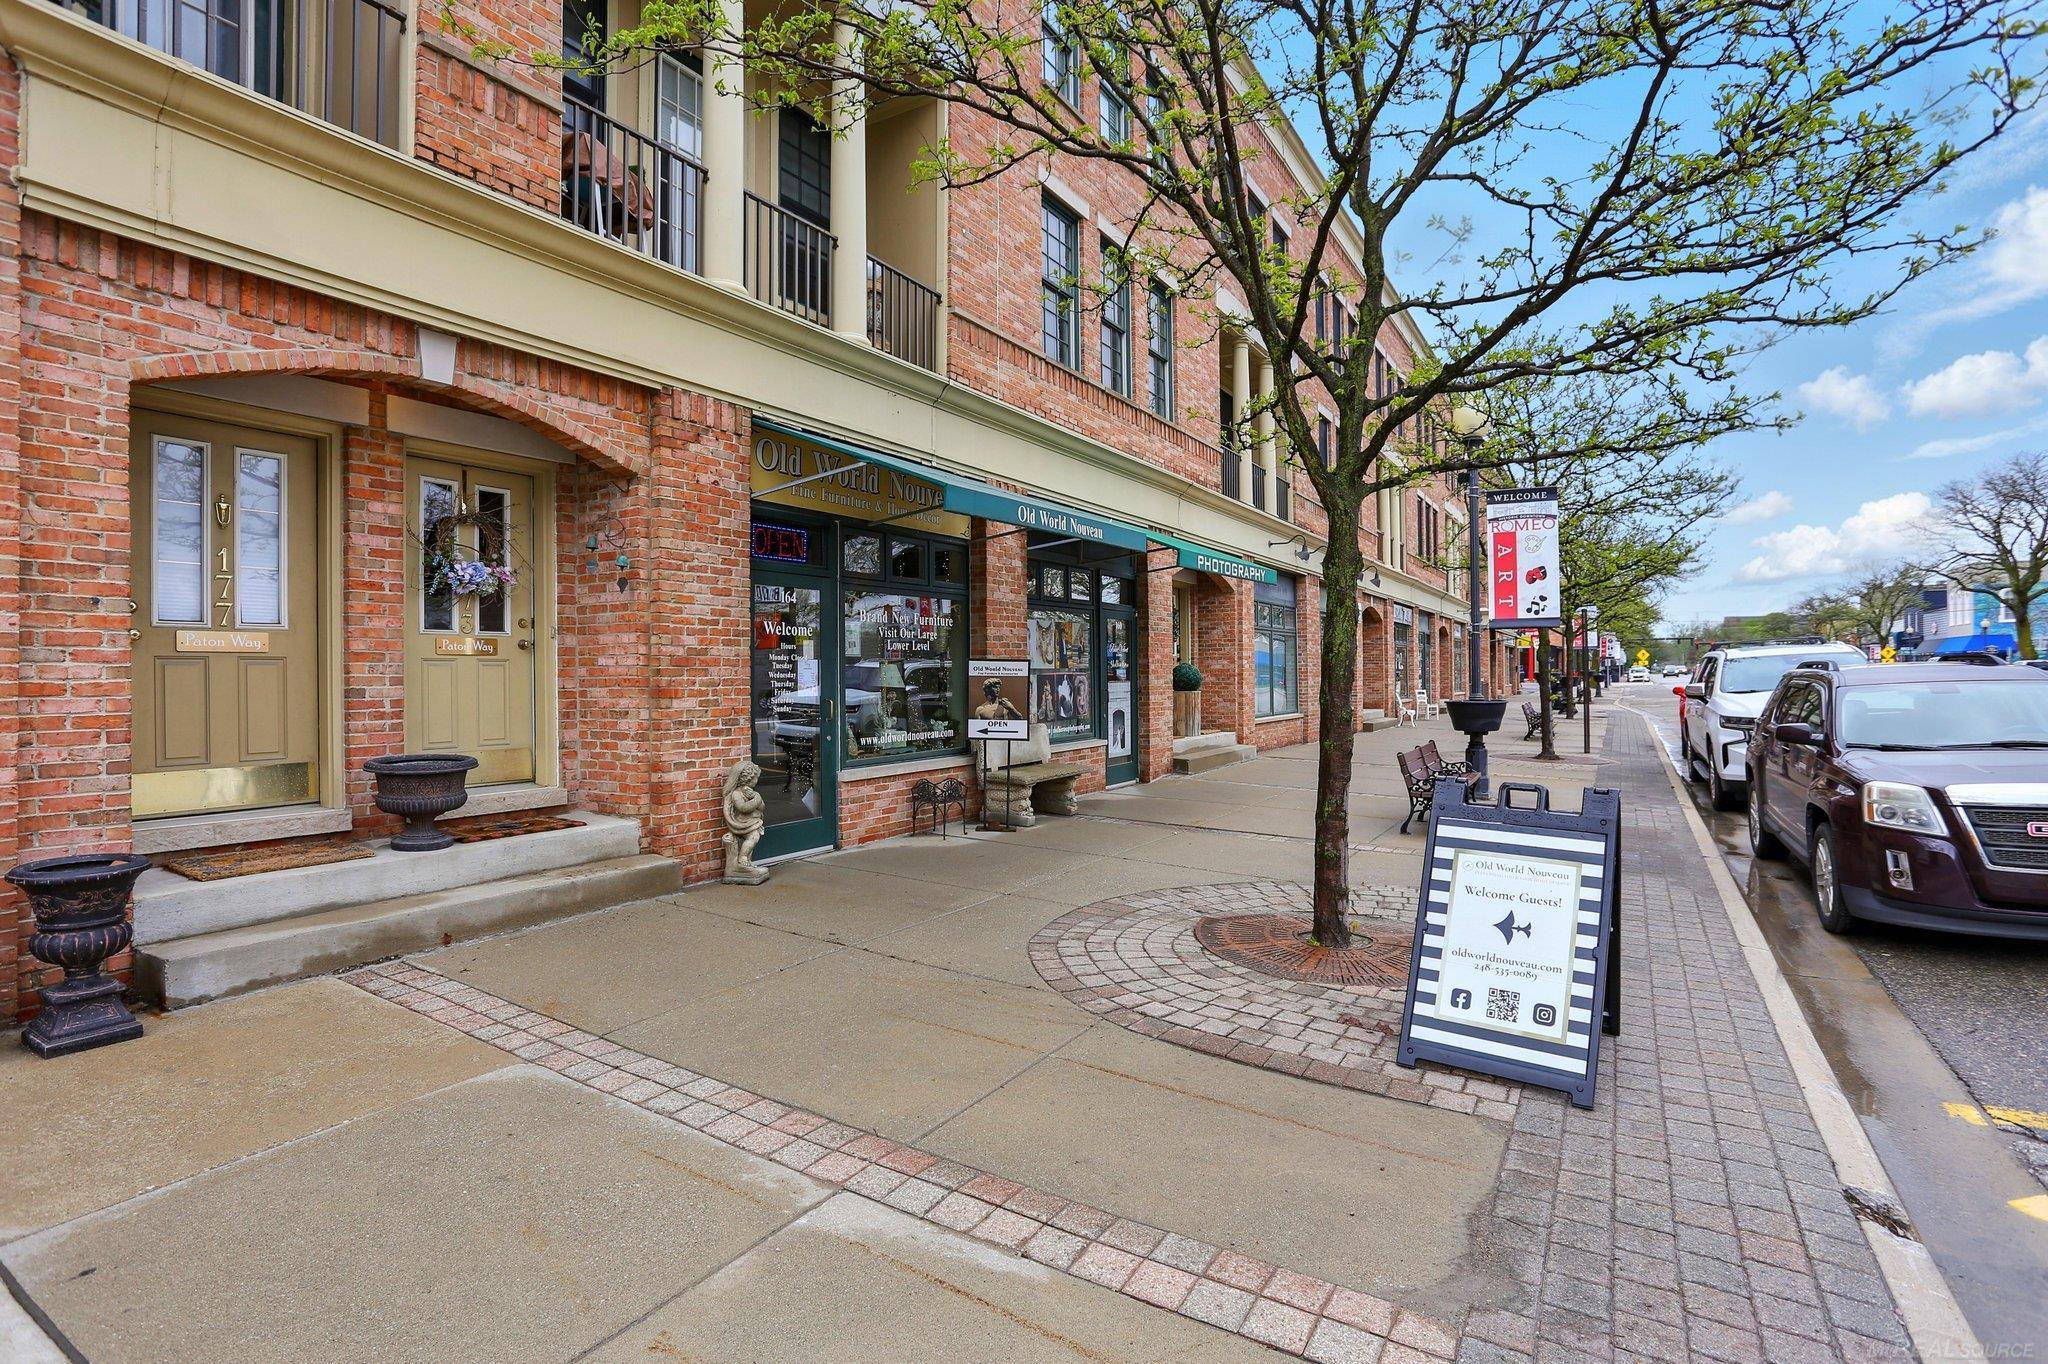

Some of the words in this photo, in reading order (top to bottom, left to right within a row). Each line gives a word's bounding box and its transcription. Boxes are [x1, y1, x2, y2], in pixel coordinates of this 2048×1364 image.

[755, 437, 802, 477] Old
[812, 450, 880, 495] World
[888, 470, 944, 507] Nouve
[791, 484, 816, 500] Fine
[821, 487, 871, 510] Furniture
[875, 501, 883, 513] &
[1493, 491, 1548, 502] WELCOME
[1018, 505, 1036, 524] Old
[1040, 510, 1067, 531] World
[1070, 518, 1103, 539] Nouveau
[1491, 518, 1555, 532] ROMEO
[754, 528, 804, 558] OPEN
[1197, 555, 1266, 582] PHOTOGRAPHY
[1497, 544, 1514, 607] ART
[214, 547, 234, 627] 177
[781, 590, 797, 604] 164
[859, 609, 888, 623] Brand
[891, 611, 911, 624] New
[914, 613, 954, 627] Furniture
[763, 620, 813, 637] Welcome
[878, 626, 897, 639] Visit
[900, 627, 915, 639] Our
[917, 629, 938, 641] Large
[184, 632, 225, 648] Paton
[230, 633, 262, 650] Way
[473, 640, 493, 653] Way
[780, 642, 797, 650] Hours
[887, 640, 910, 651] Lower
[912, 640, 930, 651] Level
[768, 654, 789, 662] Monday
[771, 662, 793, 670] Tuesday
[768, 671, 797, 679] Wednesday
[770, 680, 795, 688] Thursday
[772, 705, 792, 713] Sunday
[859, 728, 954, 746] www.oldworldnouveau.com
[1475, 861, 1493, 870] Old
[1496, 863, 1524, 874] World
[1527, 867, 1569, 880] Nouveau
[1465, 885, 1516, 902] Welcome
[1519, 892, 1562, 908] Guests!
[1451, 947, 1563, 974] oldworldnouveau.com
[1474, 963, 1538, 982] 248-535-0089
